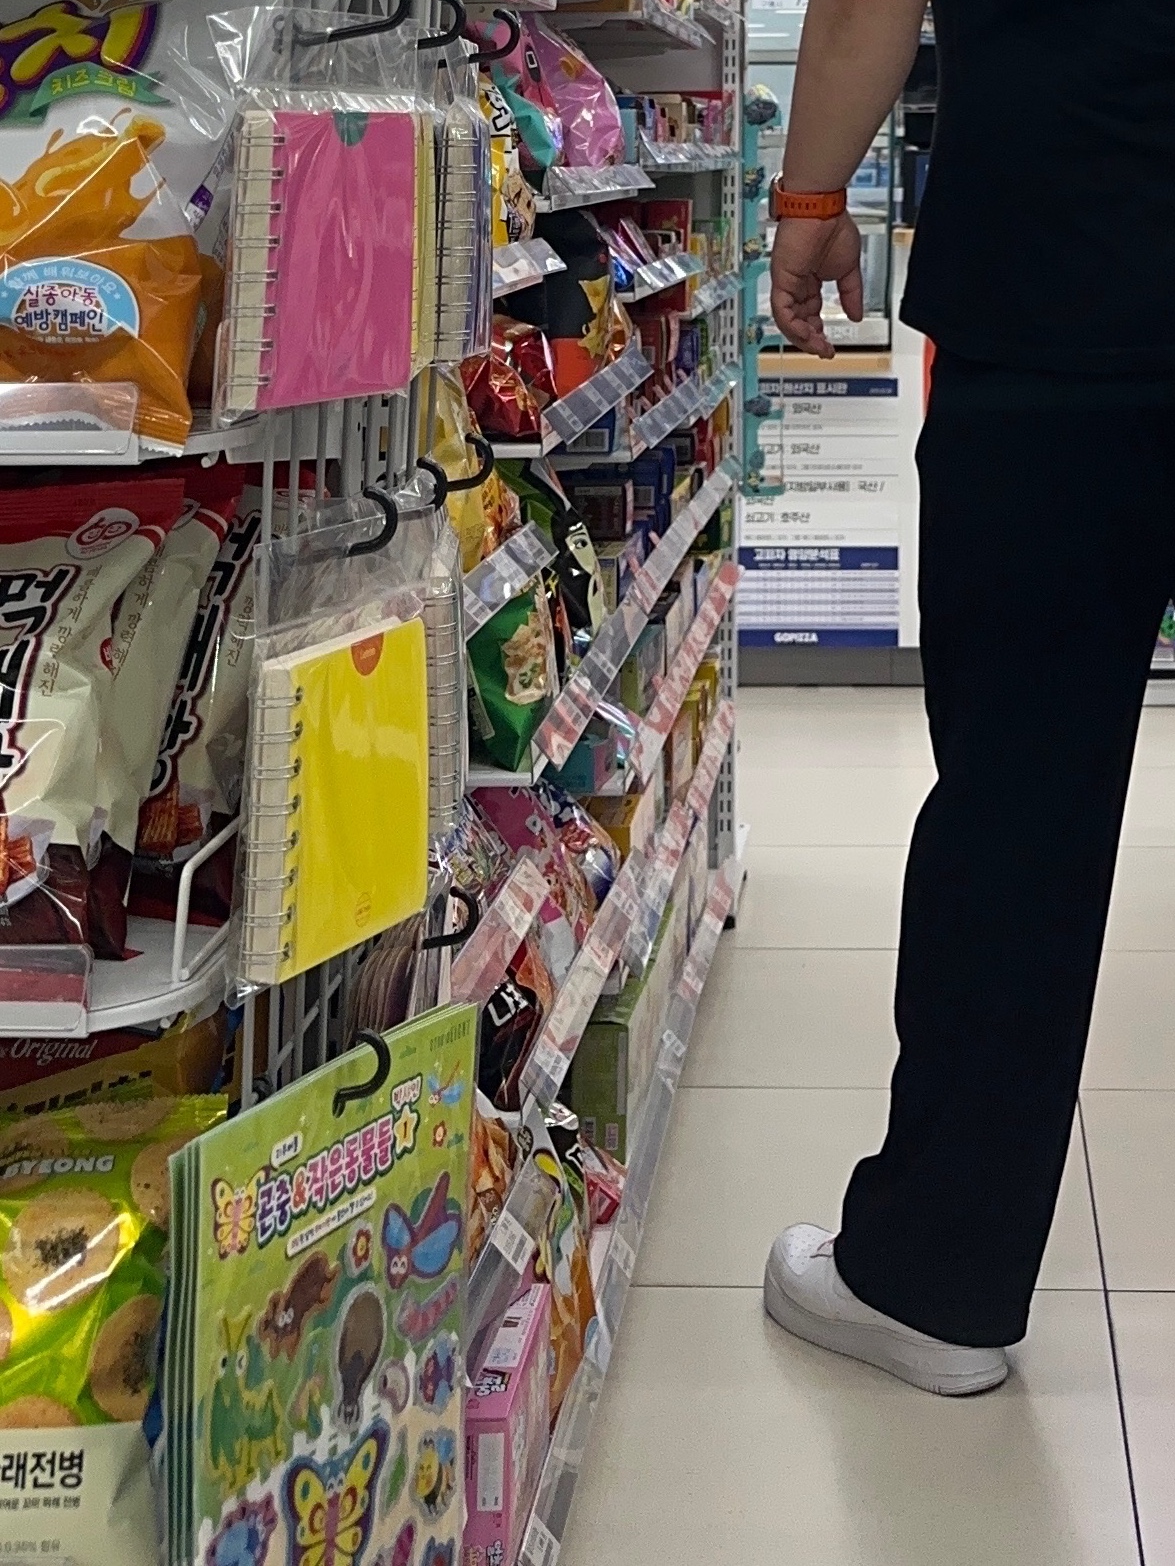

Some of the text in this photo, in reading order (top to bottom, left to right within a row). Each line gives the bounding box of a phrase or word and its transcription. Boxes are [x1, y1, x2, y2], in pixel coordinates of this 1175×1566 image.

[23, 284, 98, 308] 실종아동
[14, 308, 104, 333] 예방캠페인
[11, 1038, 98, 1066] Original
